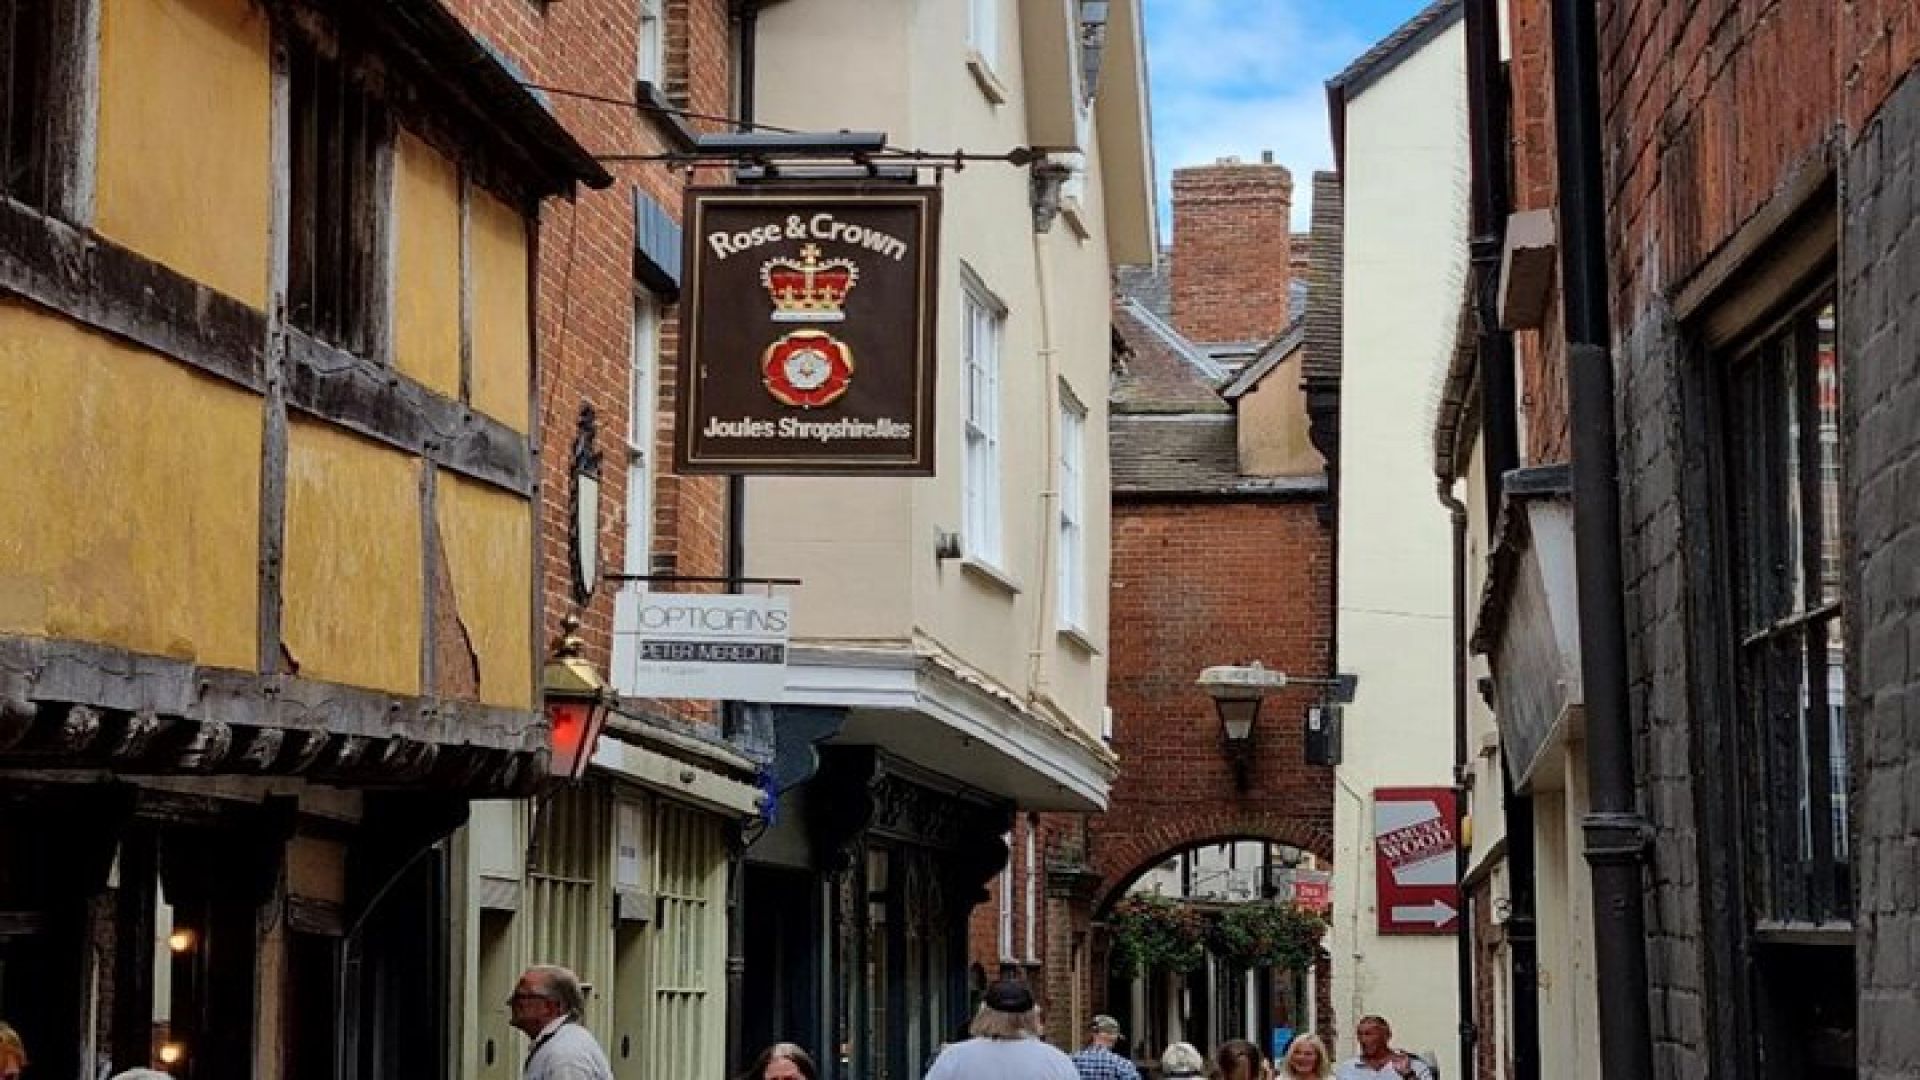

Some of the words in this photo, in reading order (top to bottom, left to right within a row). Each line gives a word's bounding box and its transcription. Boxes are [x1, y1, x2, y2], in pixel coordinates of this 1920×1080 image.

[708, 223, 782, 260] Rose
[786, 213, 807, 239] &
[810, 213, 907, 261] Crown
[1383, 829, 1452, 859] WOOD
